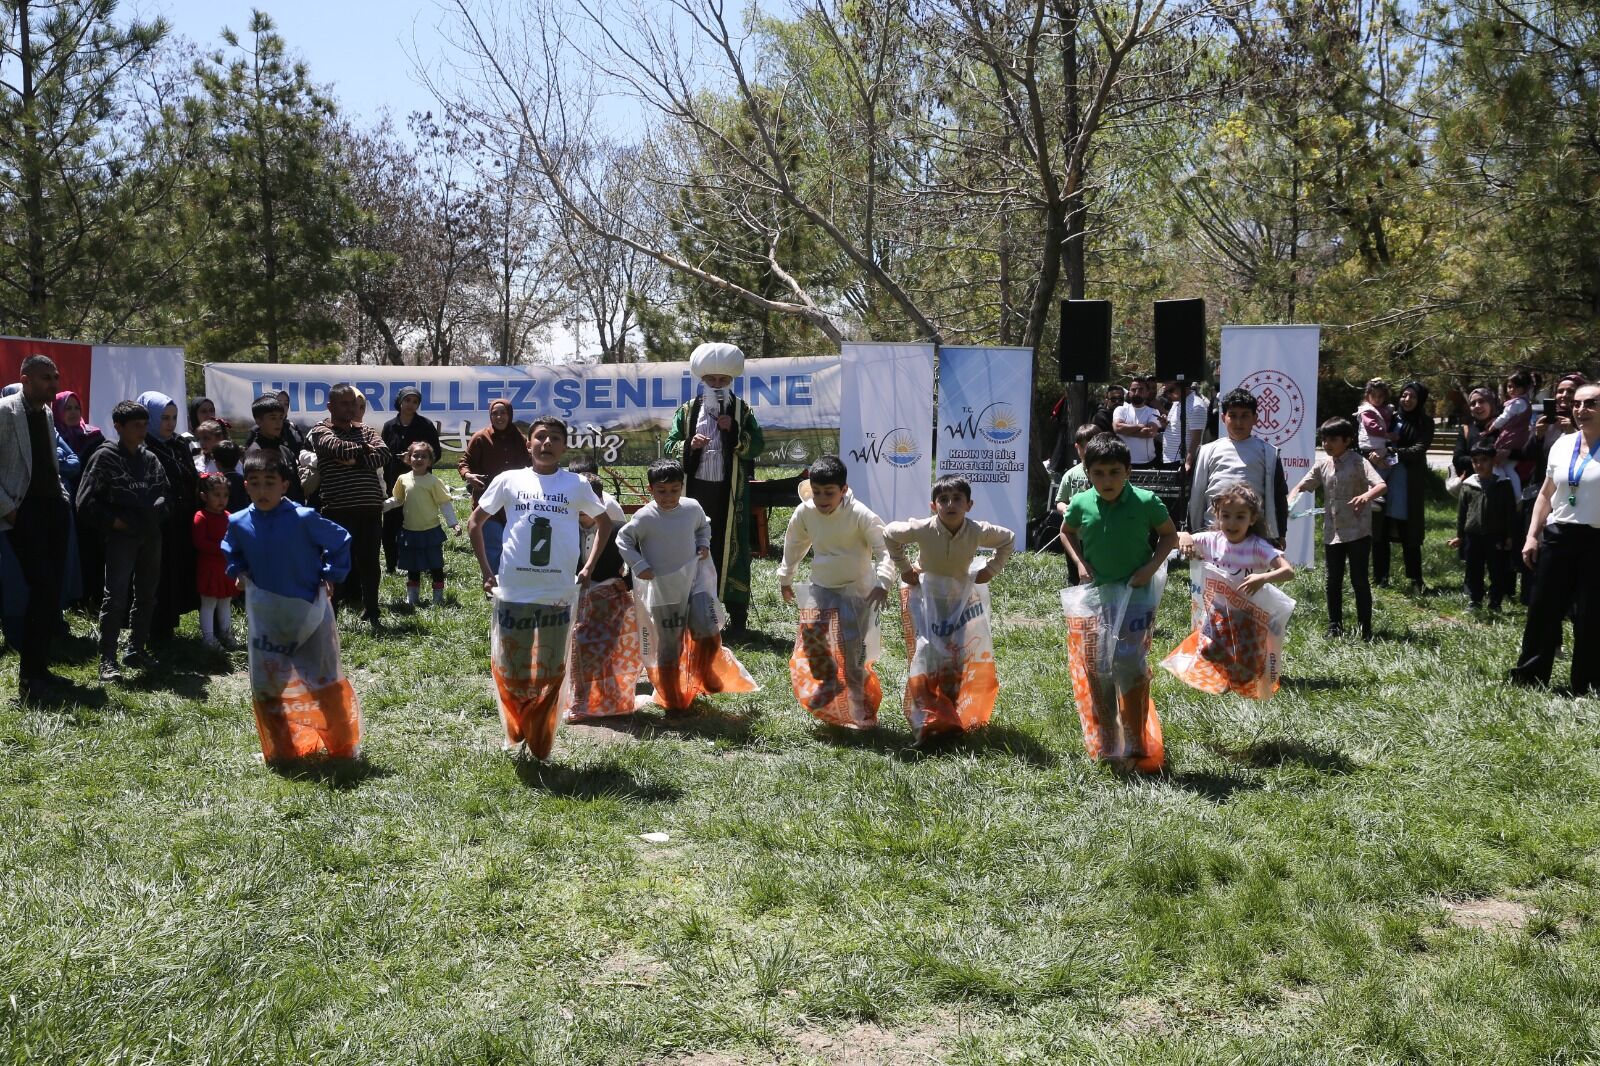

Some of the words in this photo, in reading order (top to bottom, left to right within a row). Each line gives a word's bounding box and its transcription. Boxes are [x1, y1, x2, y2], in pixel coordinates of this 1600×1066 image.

[252, 379, 537, 412] IDRELLEZ
[552, 370, 813, 417] ŞENLİİNE
[949, 449, 979, 459] KADIN
[981, 450, 993, 459] VE
[995, 448, 1016, 460] AİLE
[940, 459, 994, 471] HİZMETLERİ
[995, 460, 1024, 472] DAİRE
[1283, 456, 1310, 468] TURİZM
[954, 472, 1010, 484] AŞKANLIĞI
[516, 490, 539, 500] Find
[543, 493, 570, 505] trails,
[514, 501, 531, 511] not
[533, 503, 569, 515] excuses
